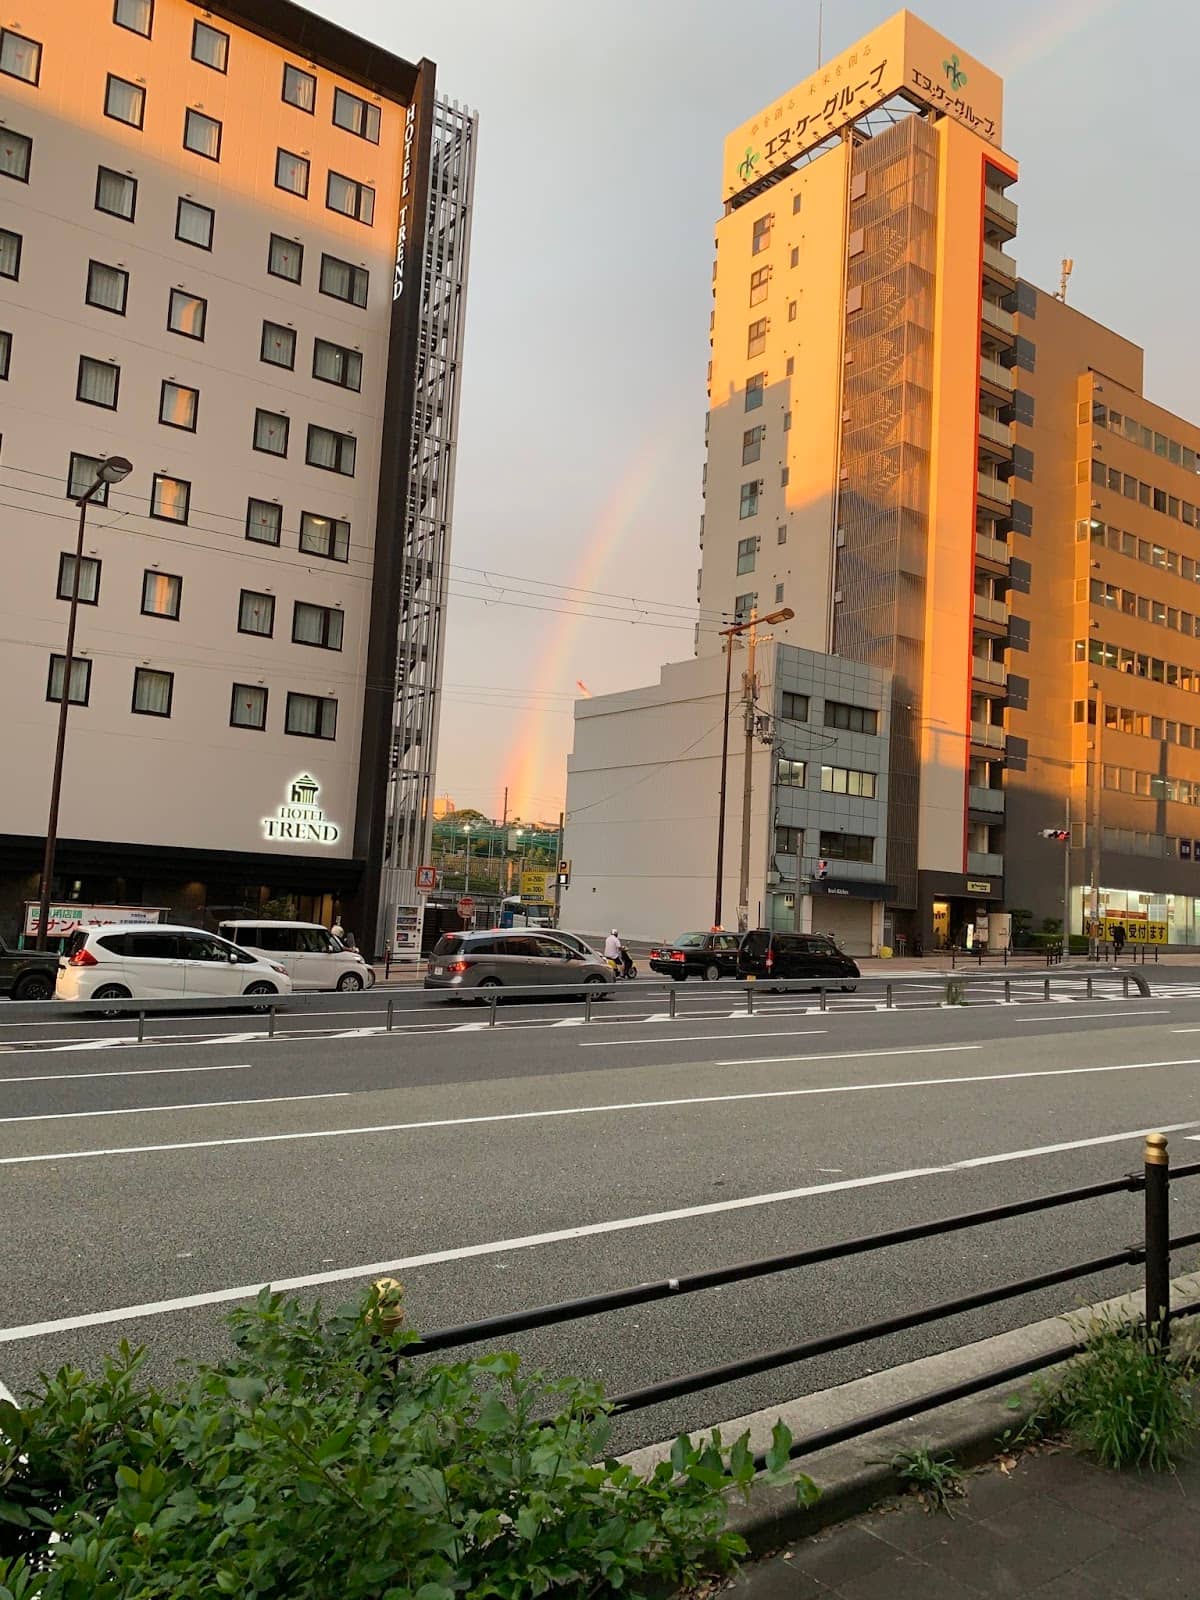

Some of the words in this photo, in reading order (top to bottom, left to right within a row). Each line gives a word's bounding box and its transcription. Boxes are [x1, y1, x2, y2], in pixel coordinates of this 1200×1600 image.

[402, 103, 415, 198] HOTEL
[393, 205, 408, 300] TREND
[281, 807, 325, 821] HOTEL
[264, 819, 339, 841] TREND
[559, 861, 567, 872] P
[1086, 922, 1166, 940] 方せ受付ます
